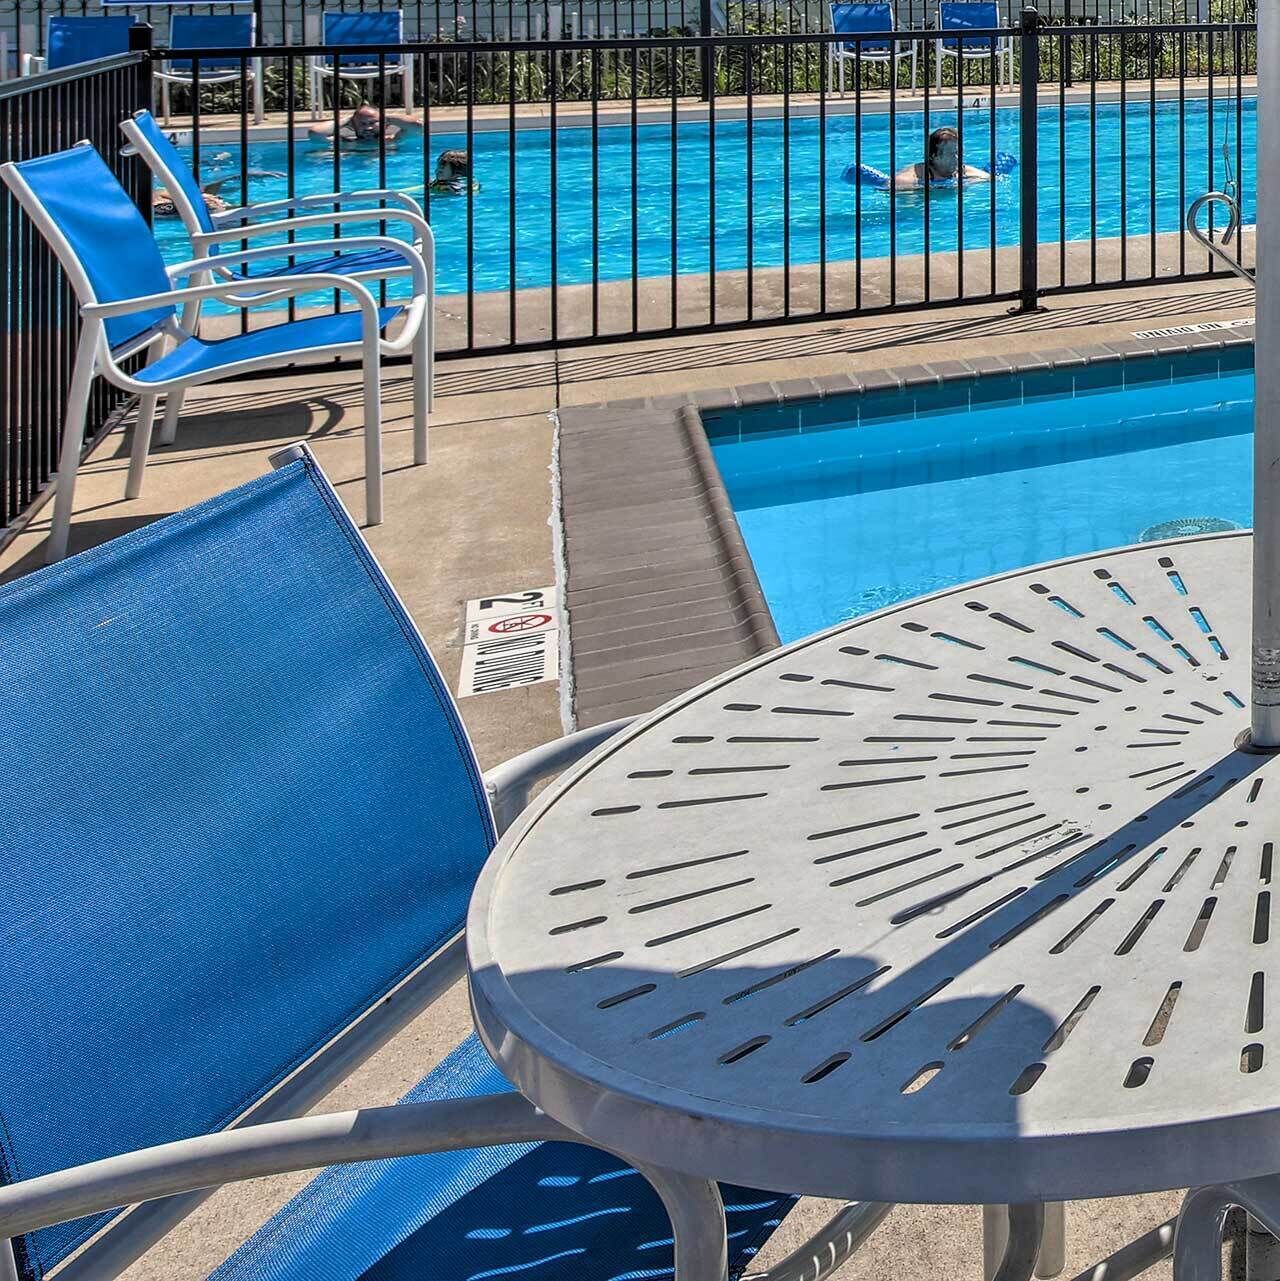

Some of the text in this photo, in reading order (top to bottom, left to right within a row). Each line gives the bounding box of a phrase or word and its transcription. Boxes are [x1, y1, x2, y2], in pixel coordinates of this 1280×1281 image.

[1136, 321, 1223, 339] NO DIVING
[480, 591, 544, 610] 2
[473, 633, 546, 693] NO DIVING
